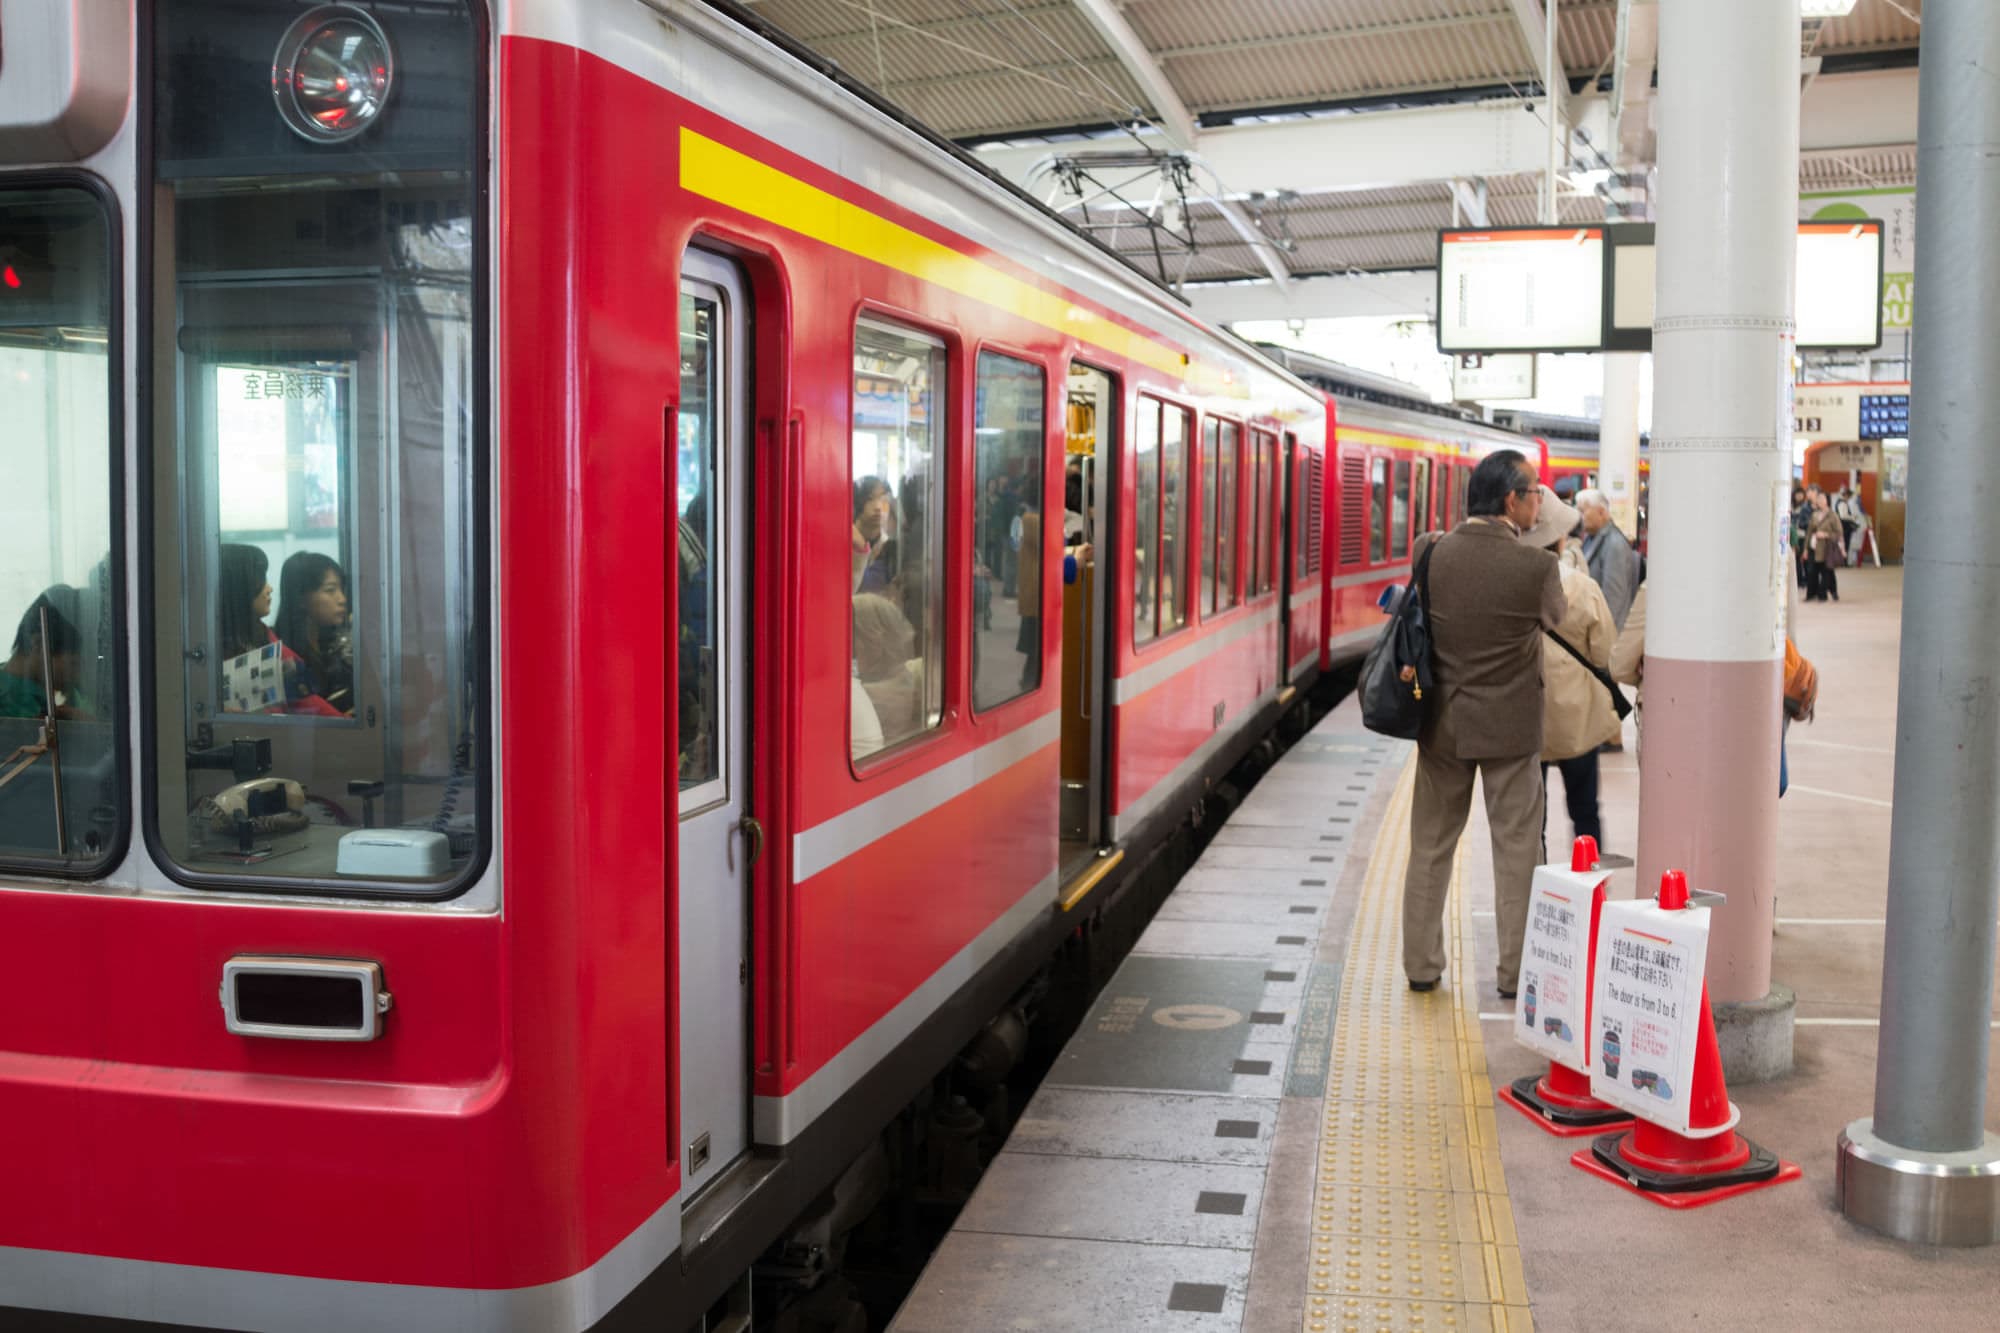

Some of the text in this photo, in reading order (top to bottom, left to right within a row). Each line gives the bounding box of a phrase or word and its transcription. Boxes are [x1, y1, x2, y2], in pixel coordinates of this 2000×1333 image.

[1608, 982, 1619, 1001] The
[1619, 987, 1633, 1005] door
[1633, 992, 1640, 1007] is
[1641, 993, 1656, 1012] from
[1657, 998, 1663, 1016] 3
[1662, 1001, 1671, 1017] to
